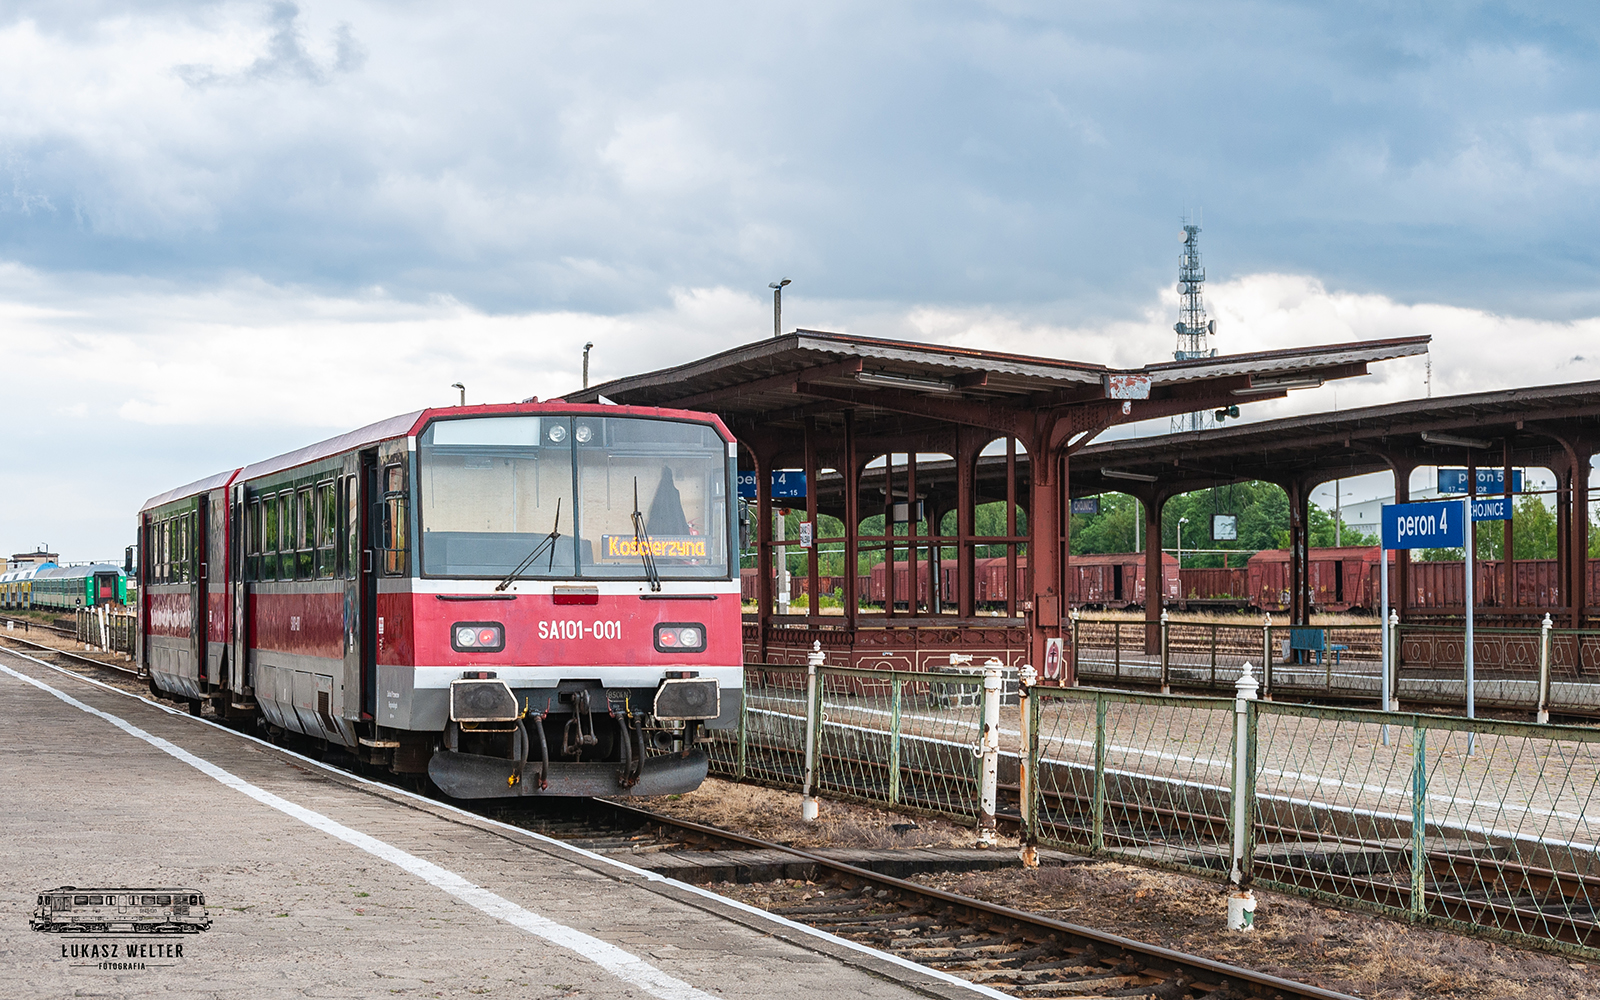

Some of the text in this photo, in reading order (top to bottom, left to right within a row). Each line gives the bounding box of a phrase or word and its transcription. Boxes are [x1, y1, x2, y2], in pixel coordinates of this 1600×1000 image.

[738, 473, 786, 484] per 4
[1459, 472, 1504, 484] pon 5
[1471, 502, 1503, 517] HOJNICE
[1397, 507, 1448, 543] peron 4
[608, 535, 707, 556] Kościerzyna
[538, 620, 622, 639] SA101-001
